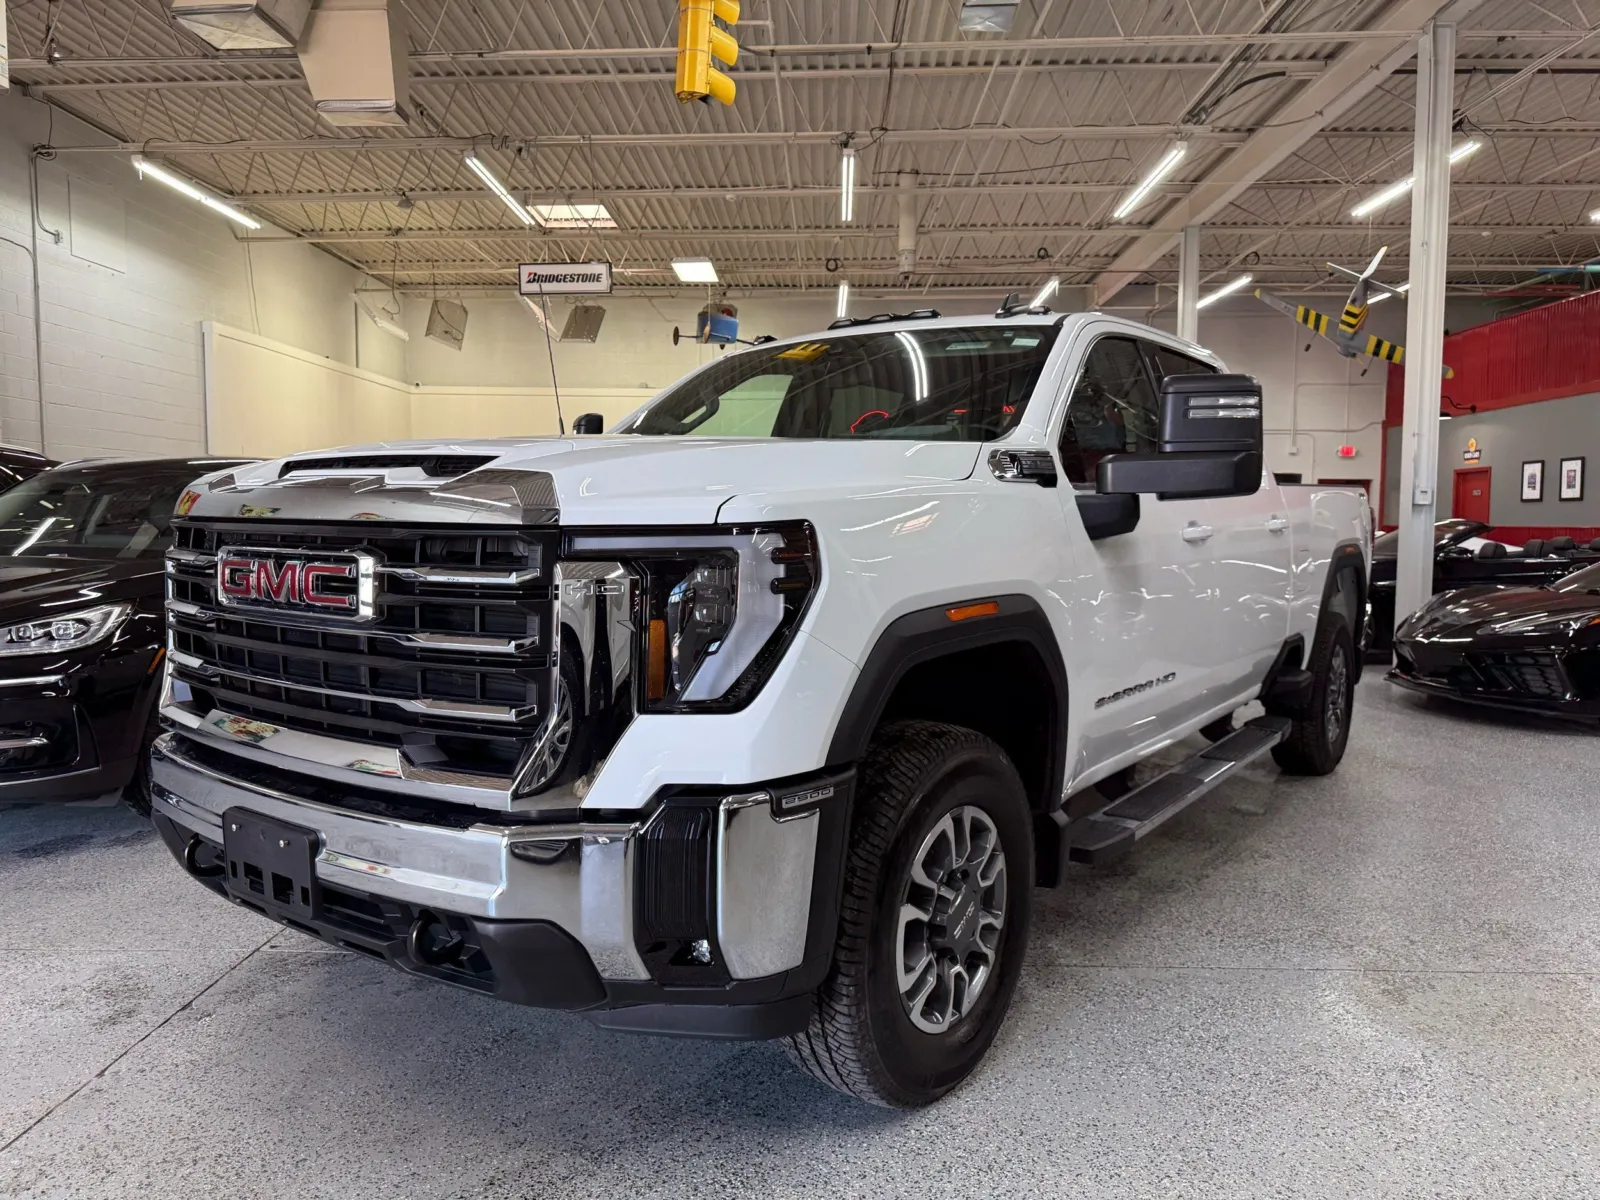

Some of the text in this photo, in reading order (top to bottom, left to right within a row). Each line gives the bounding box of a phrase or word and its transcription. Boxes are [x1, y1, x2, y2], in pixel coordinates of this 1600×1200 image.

[526, 272, 603, 284] BRIDGESTONE
[221, 559, 357, 609] GMC
[1094, 680, 1154, 710] SIERRA
[784, 788, 832, 805] 2500
